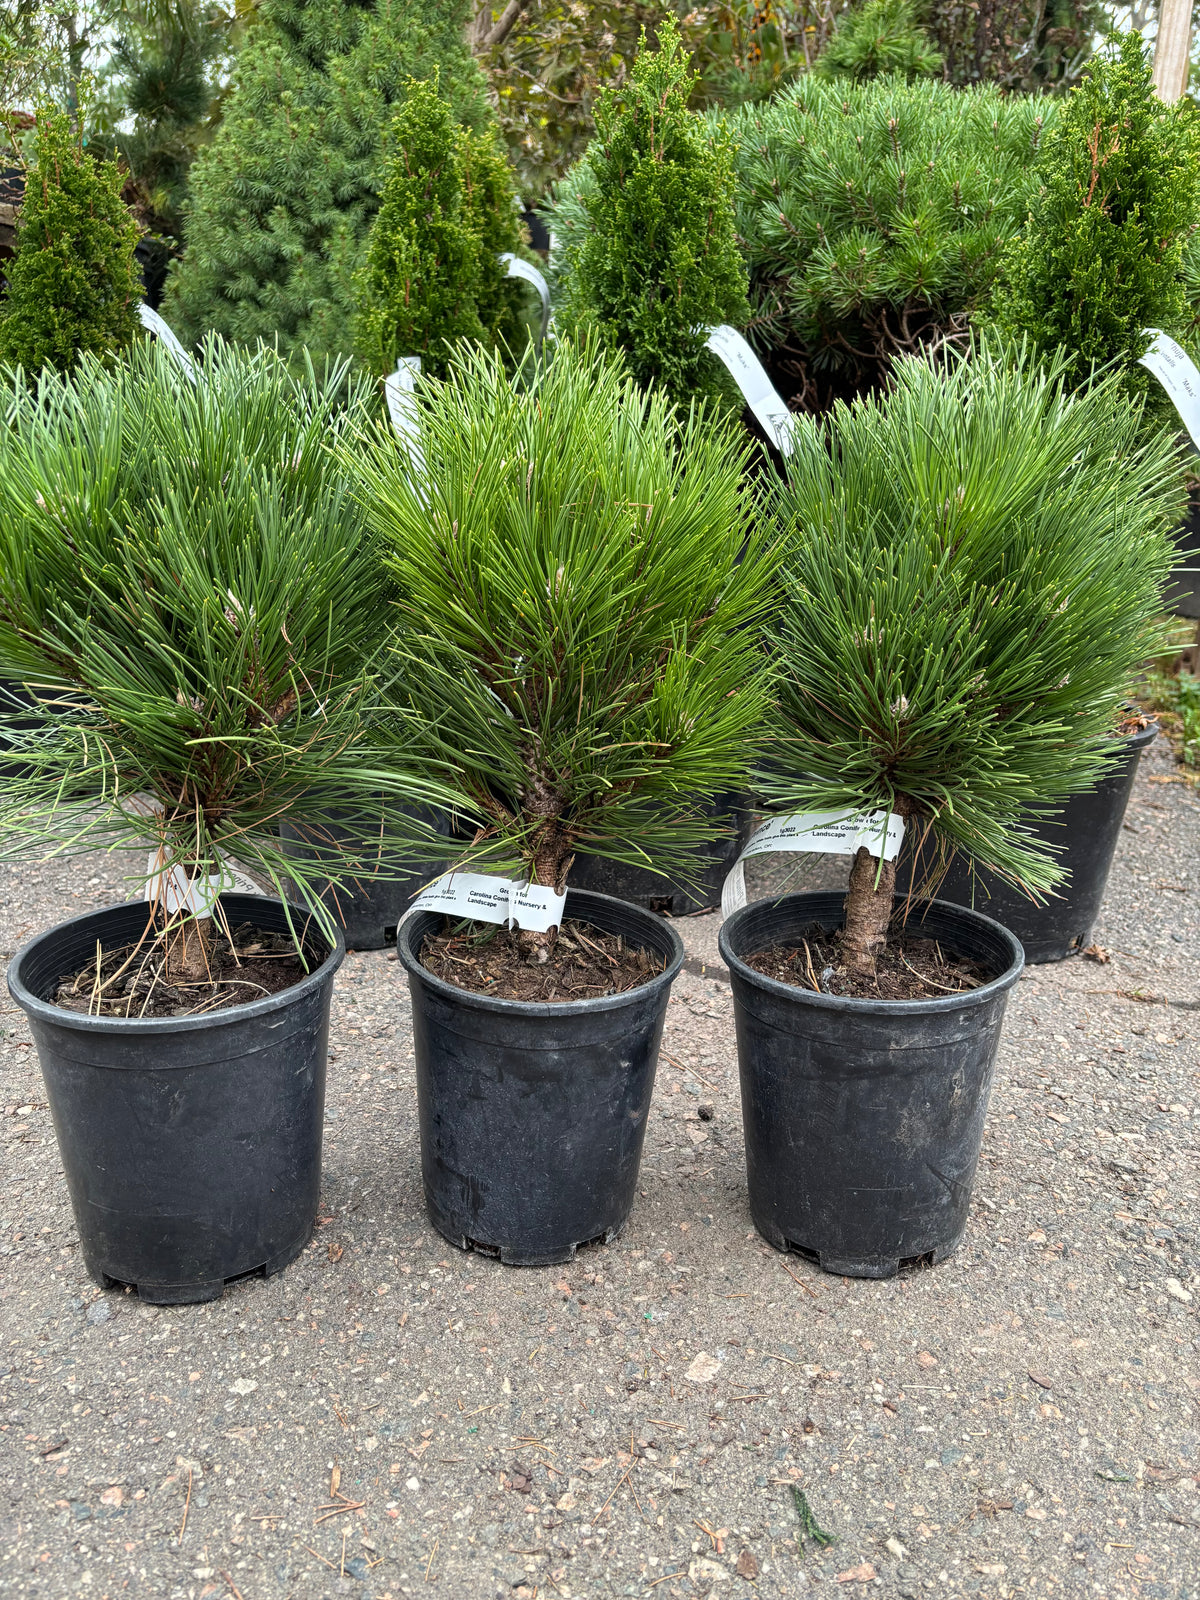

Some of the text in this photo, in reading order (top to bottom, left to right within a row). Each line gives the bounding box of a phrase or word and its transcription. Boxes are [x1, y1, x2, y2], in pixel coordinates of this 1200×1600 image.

[467, 897, 498, 908] Landscape
[469, 890, 492, 900] Carolina
[518, 899, 541, 910] Nursery
